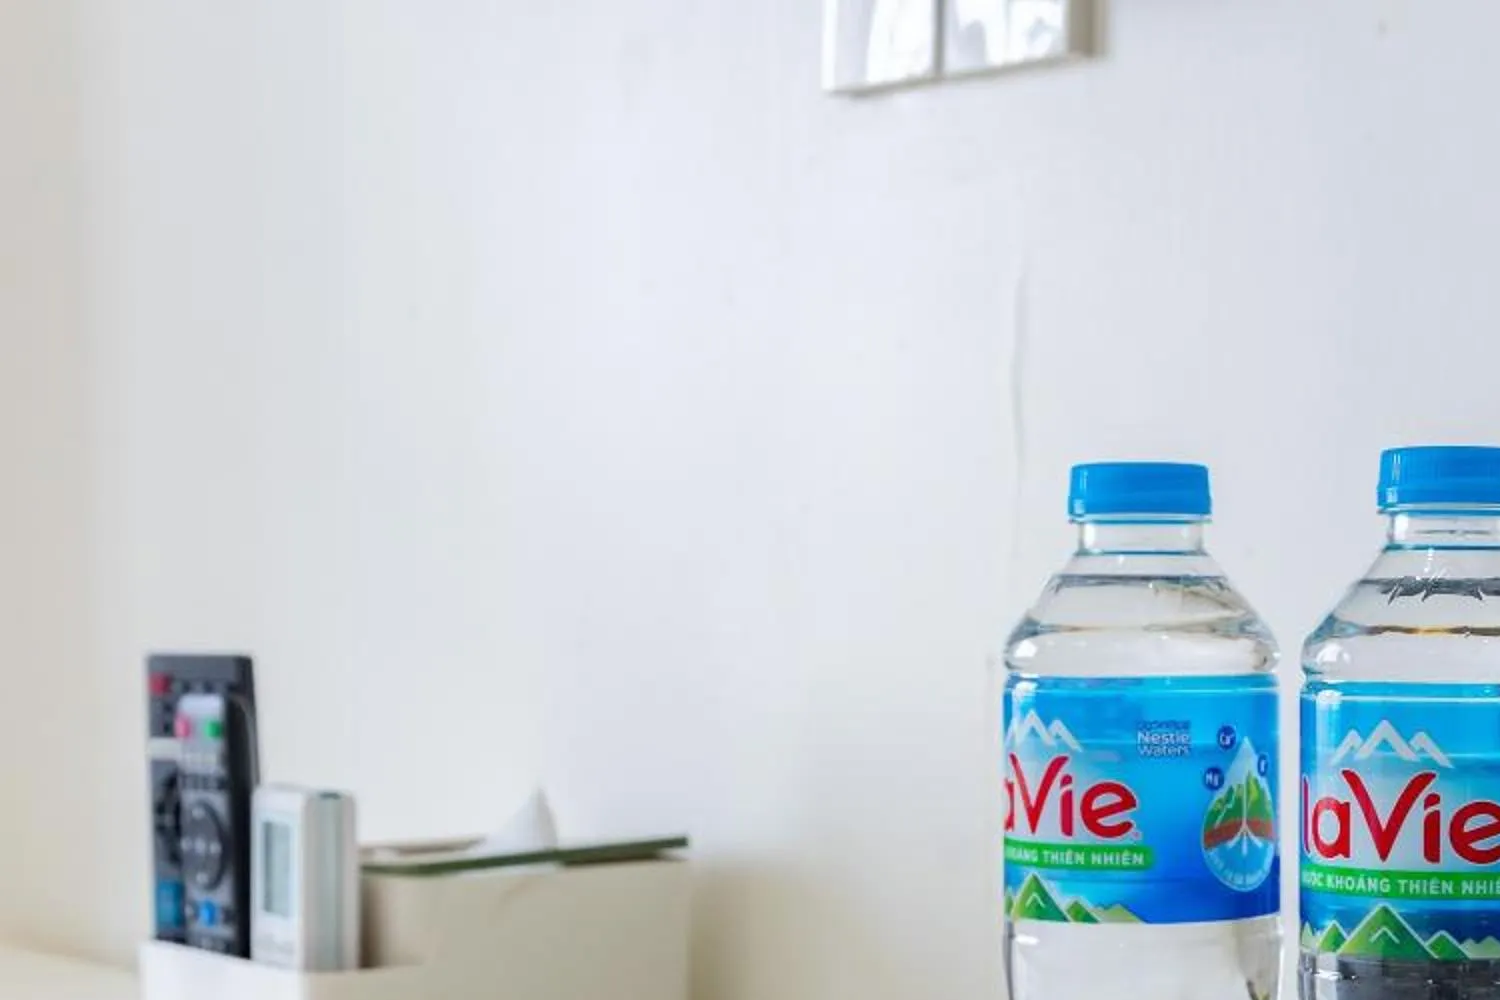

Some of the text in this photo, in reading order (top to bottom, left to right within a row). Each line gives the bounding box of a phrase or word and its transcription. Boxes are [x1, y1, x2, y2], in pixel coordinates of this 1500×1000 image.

[1091, 849, 1145, 866] NHIÊN
[1326, 873, 1391, 893] KHOÁNG
[1397, 876, 1454, 895] THIÊN
